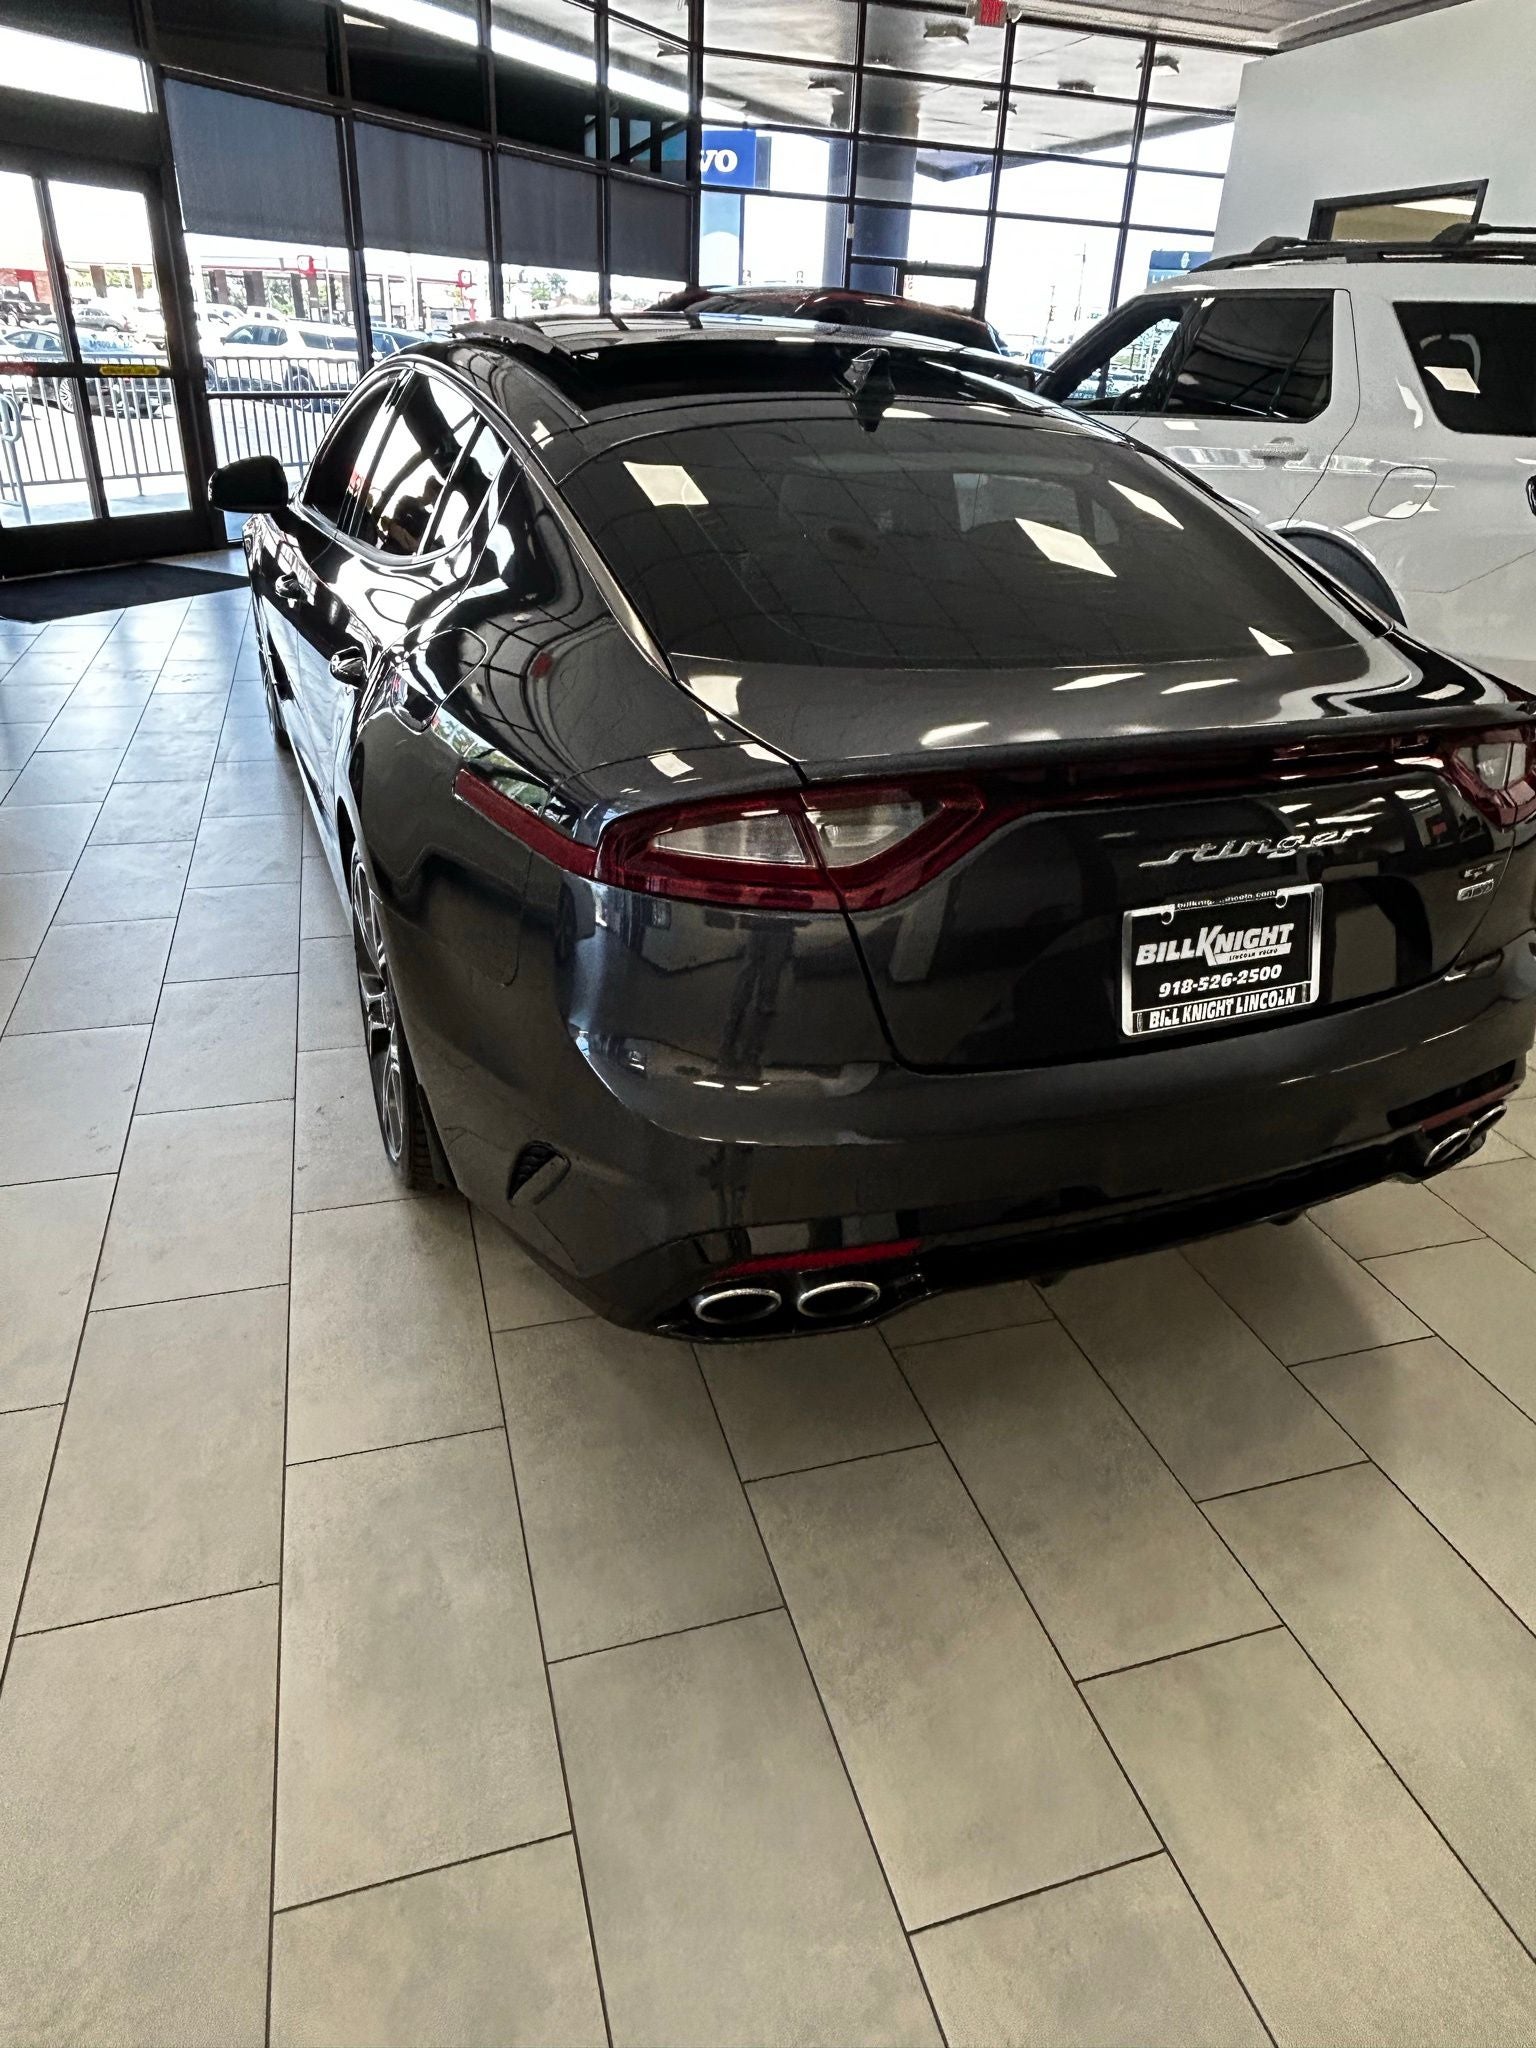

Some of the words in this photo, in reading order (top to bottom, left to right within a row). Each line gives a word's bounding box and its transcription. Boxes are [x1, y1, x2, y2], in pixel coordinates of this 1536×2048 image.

[1158, 964, 1283, 998] 918-526-2500
[1149, 1008, 1180, 1030] BILL
[1182, 997, 1236, 1024] KNIGHT
[1235, 986, 1297, 1014] LINCOLN
